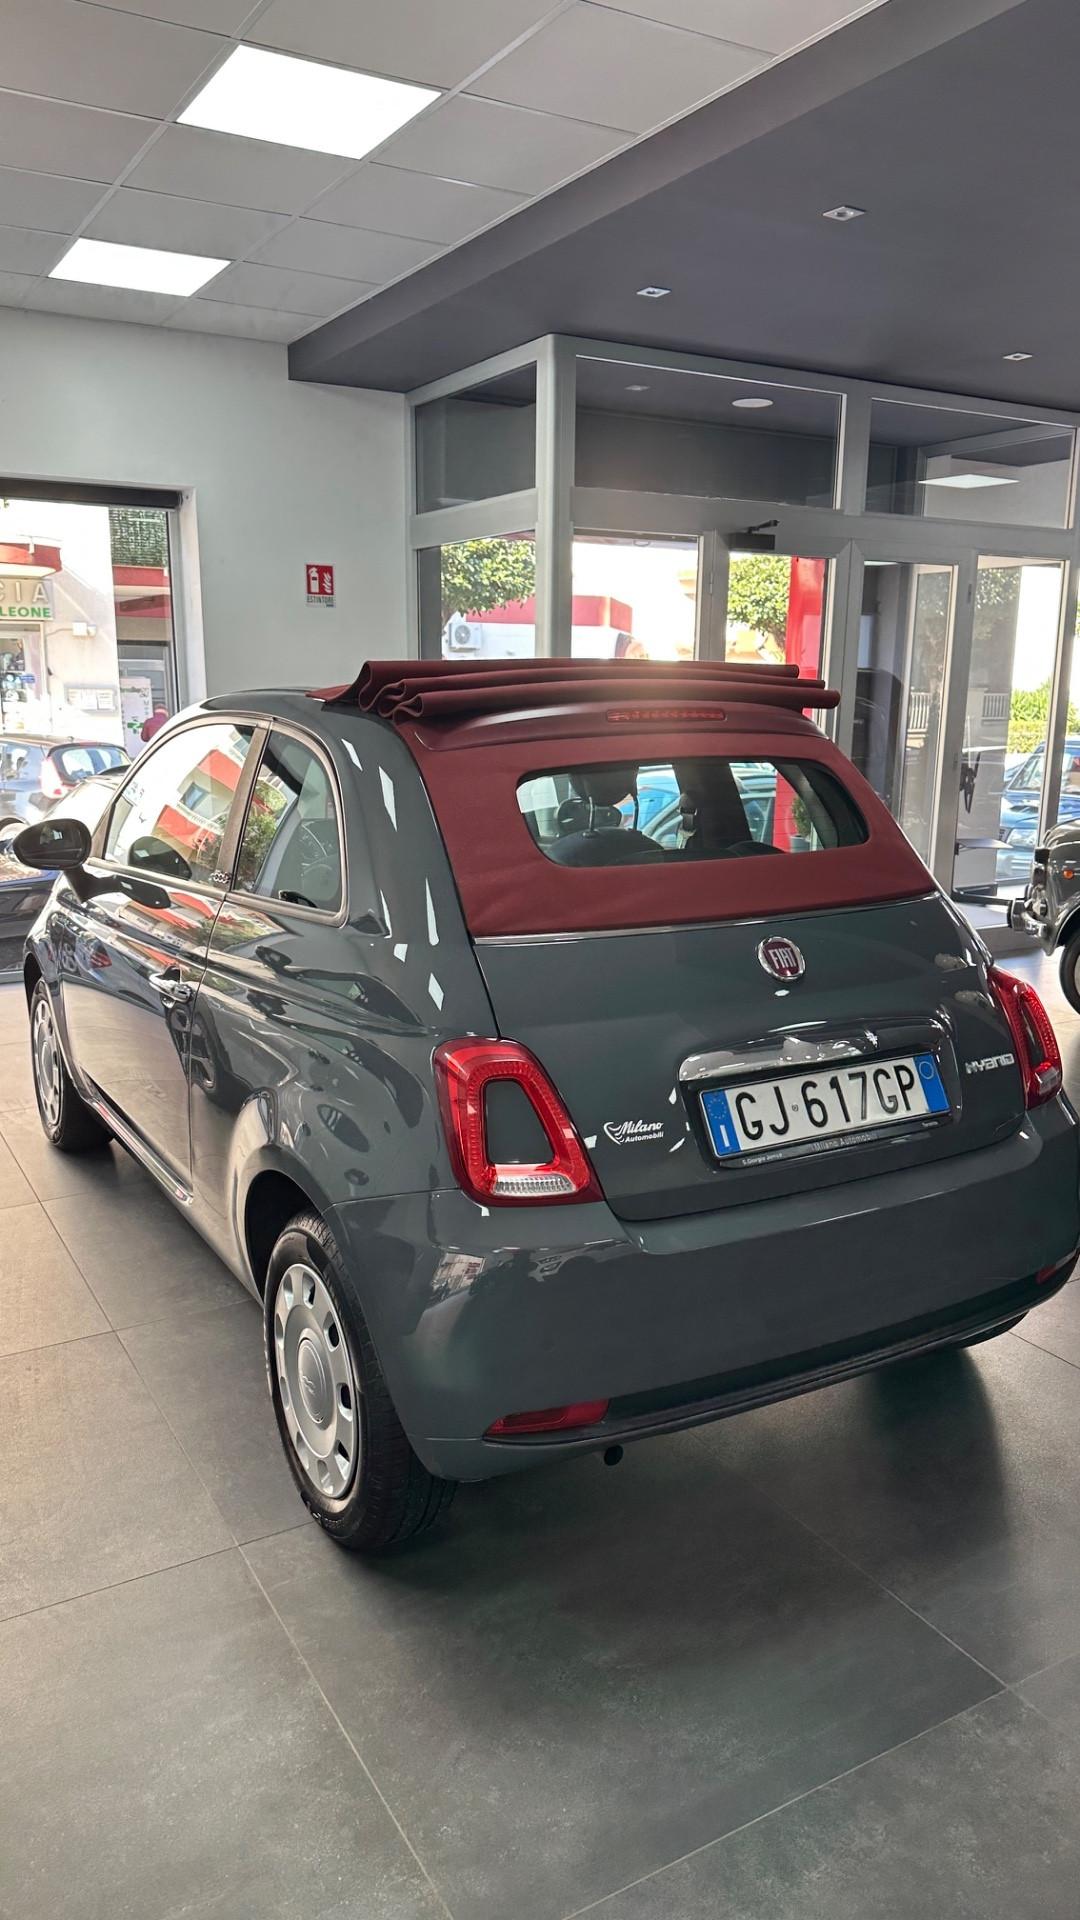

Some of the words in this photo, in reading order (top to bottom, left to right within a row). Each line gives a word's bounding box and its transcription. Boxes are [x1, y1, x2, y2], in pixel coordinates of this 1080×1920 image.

[768, 947, 797, 970] FIAT
[964, 1053, 1015, 1075] HYBRID
[614, 1119, 665, 1136] Milano
[624, 1131, 665, 1143] Automobili
